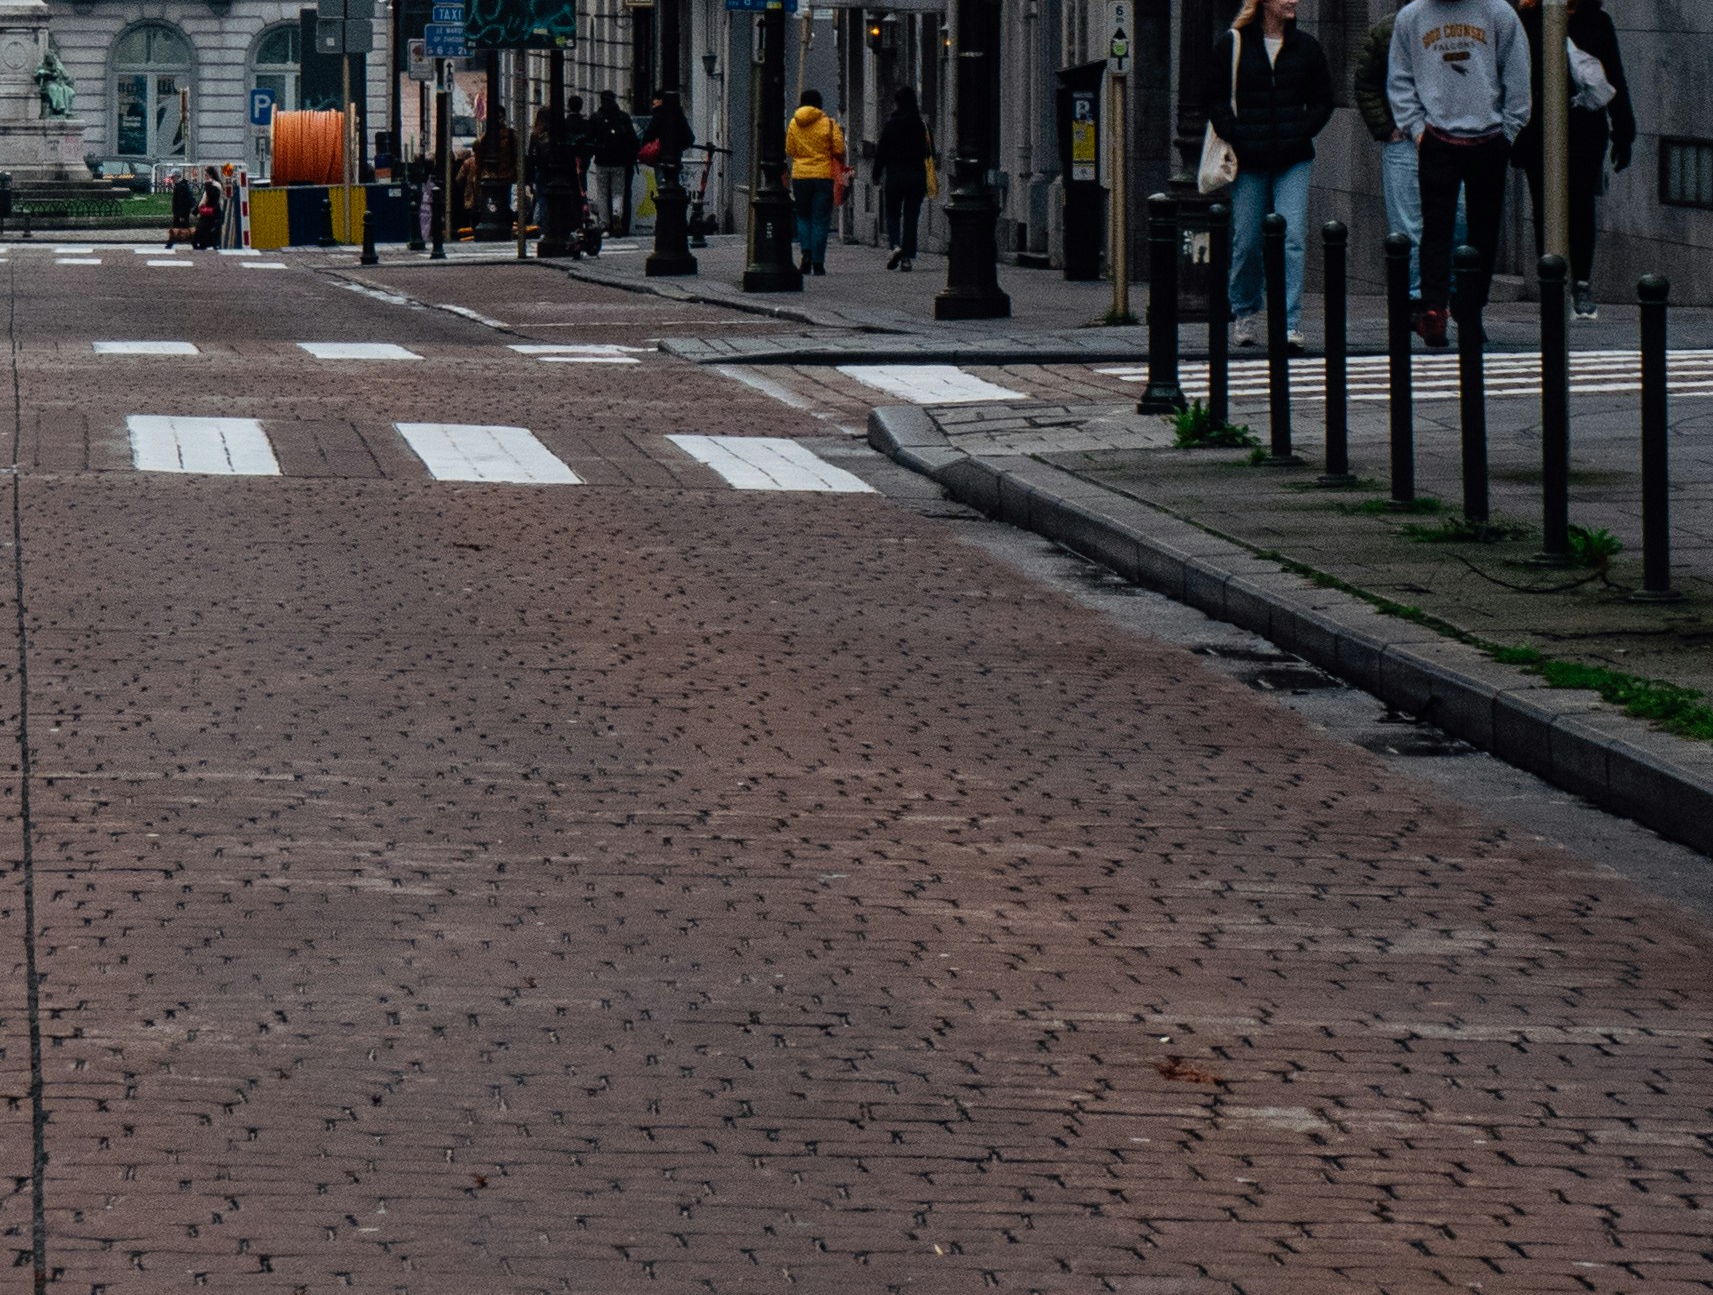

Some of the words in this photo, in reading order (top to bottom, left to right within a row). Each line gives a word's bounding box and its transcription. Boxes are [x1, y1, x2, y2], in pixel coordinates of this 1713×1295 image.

[439, 8, 463, 21] TAXI
[1115, 5, 1124, 17] 6
[254, 94, 272, 119] P
[1075, 99, 1090, 120] P
